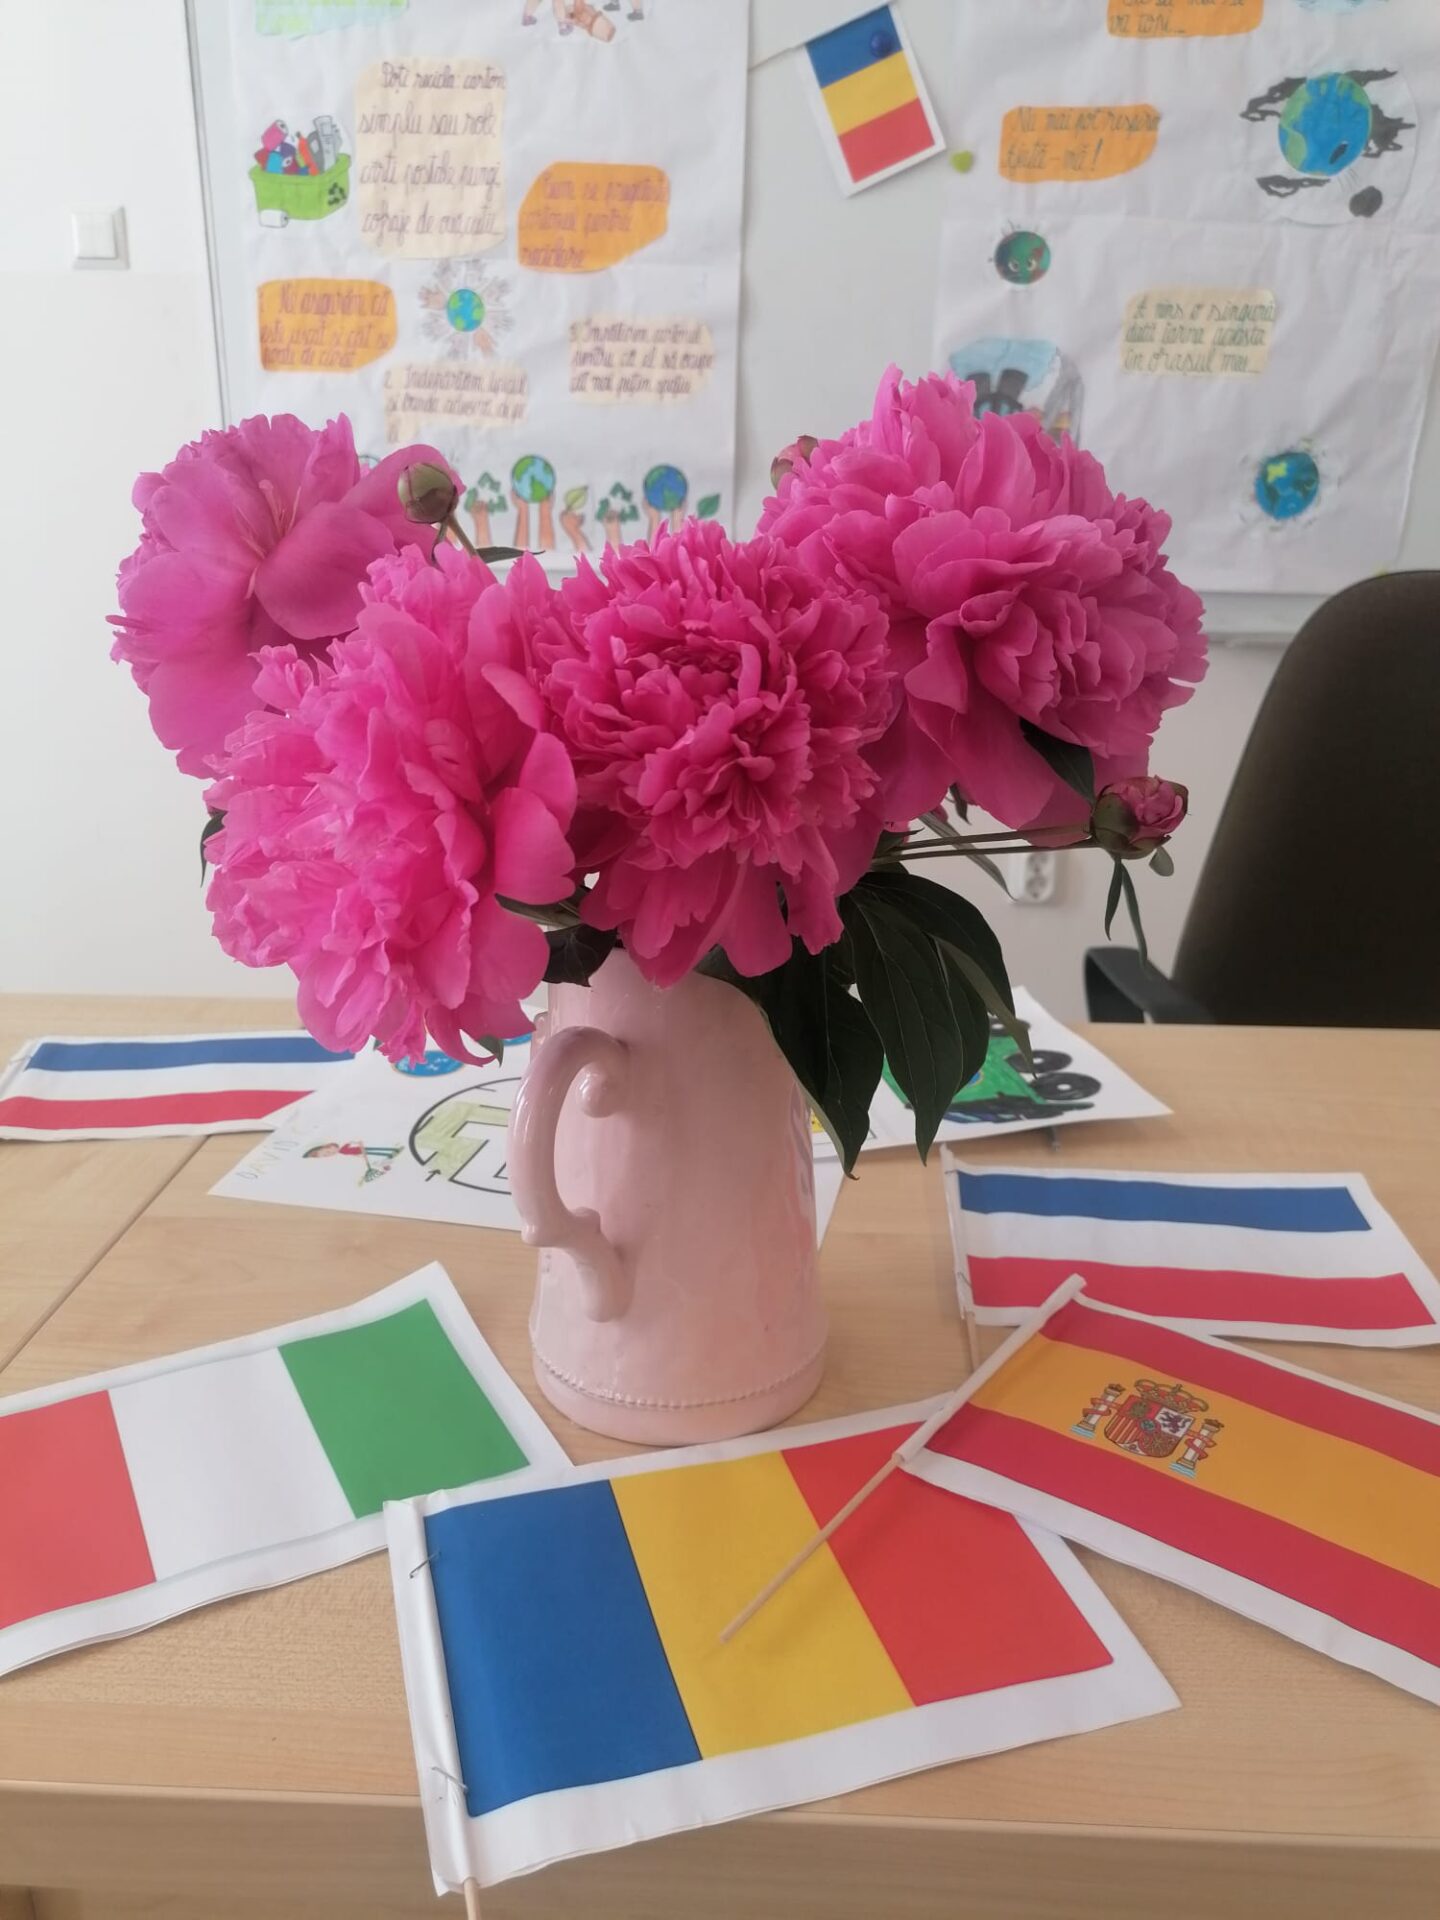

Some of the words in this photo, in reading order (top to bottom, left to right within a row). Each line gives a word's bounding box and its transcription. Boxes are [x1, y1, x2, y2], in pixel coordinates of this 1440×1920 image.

[357, 101, 423, 149] simplu
[429, 113, 458, 136] sau
[416, 202, 435, 235] de
